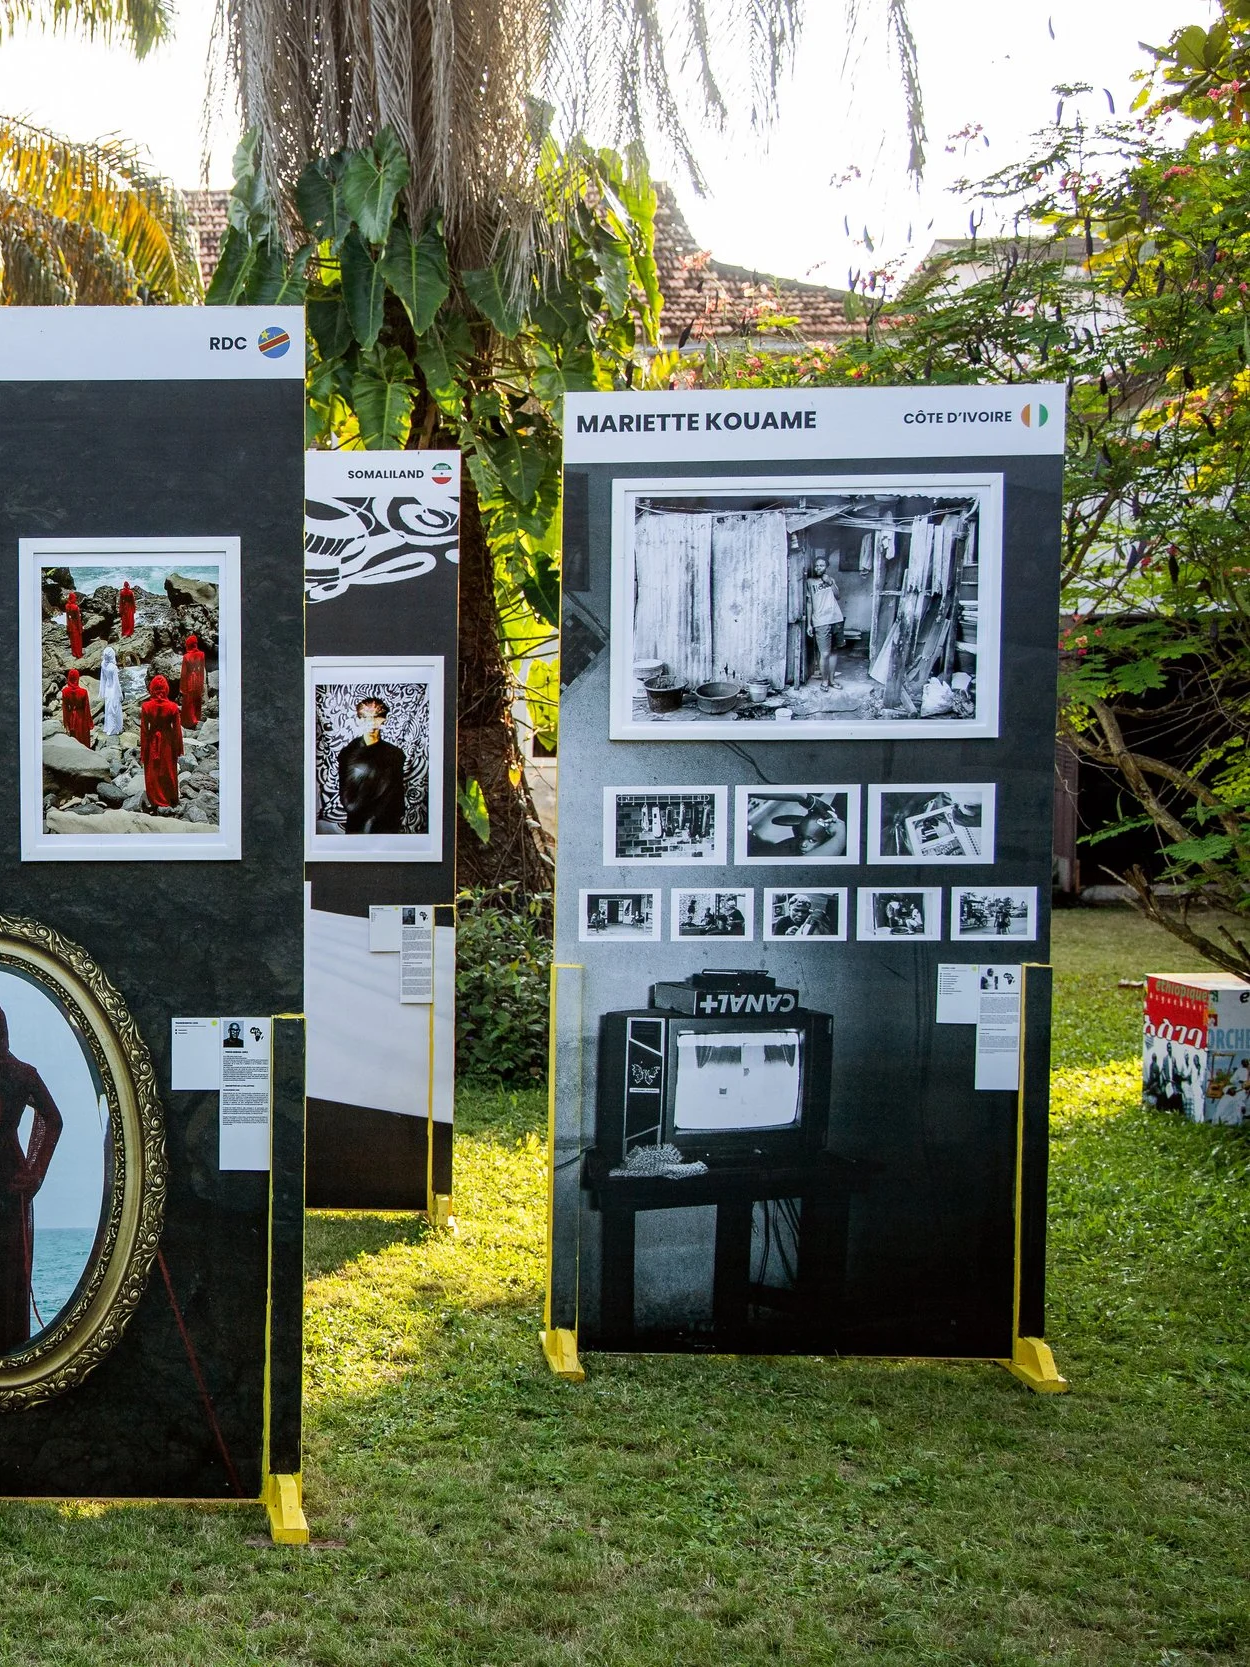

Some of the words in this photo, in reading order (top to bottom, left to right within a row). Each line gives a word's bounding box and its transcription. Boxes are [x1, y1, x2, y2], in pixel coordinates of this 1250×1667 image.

[209, 336, 247, 351] RDC
[576, 413, 700, 433] MARIETTE
[705, 410, 817, 431] KOUAME
[903, 409, 944, 424] CÔTE
[347, 469, 425, 479] SOMALILAND
[700, 994, 795, 1013] CANAL+
